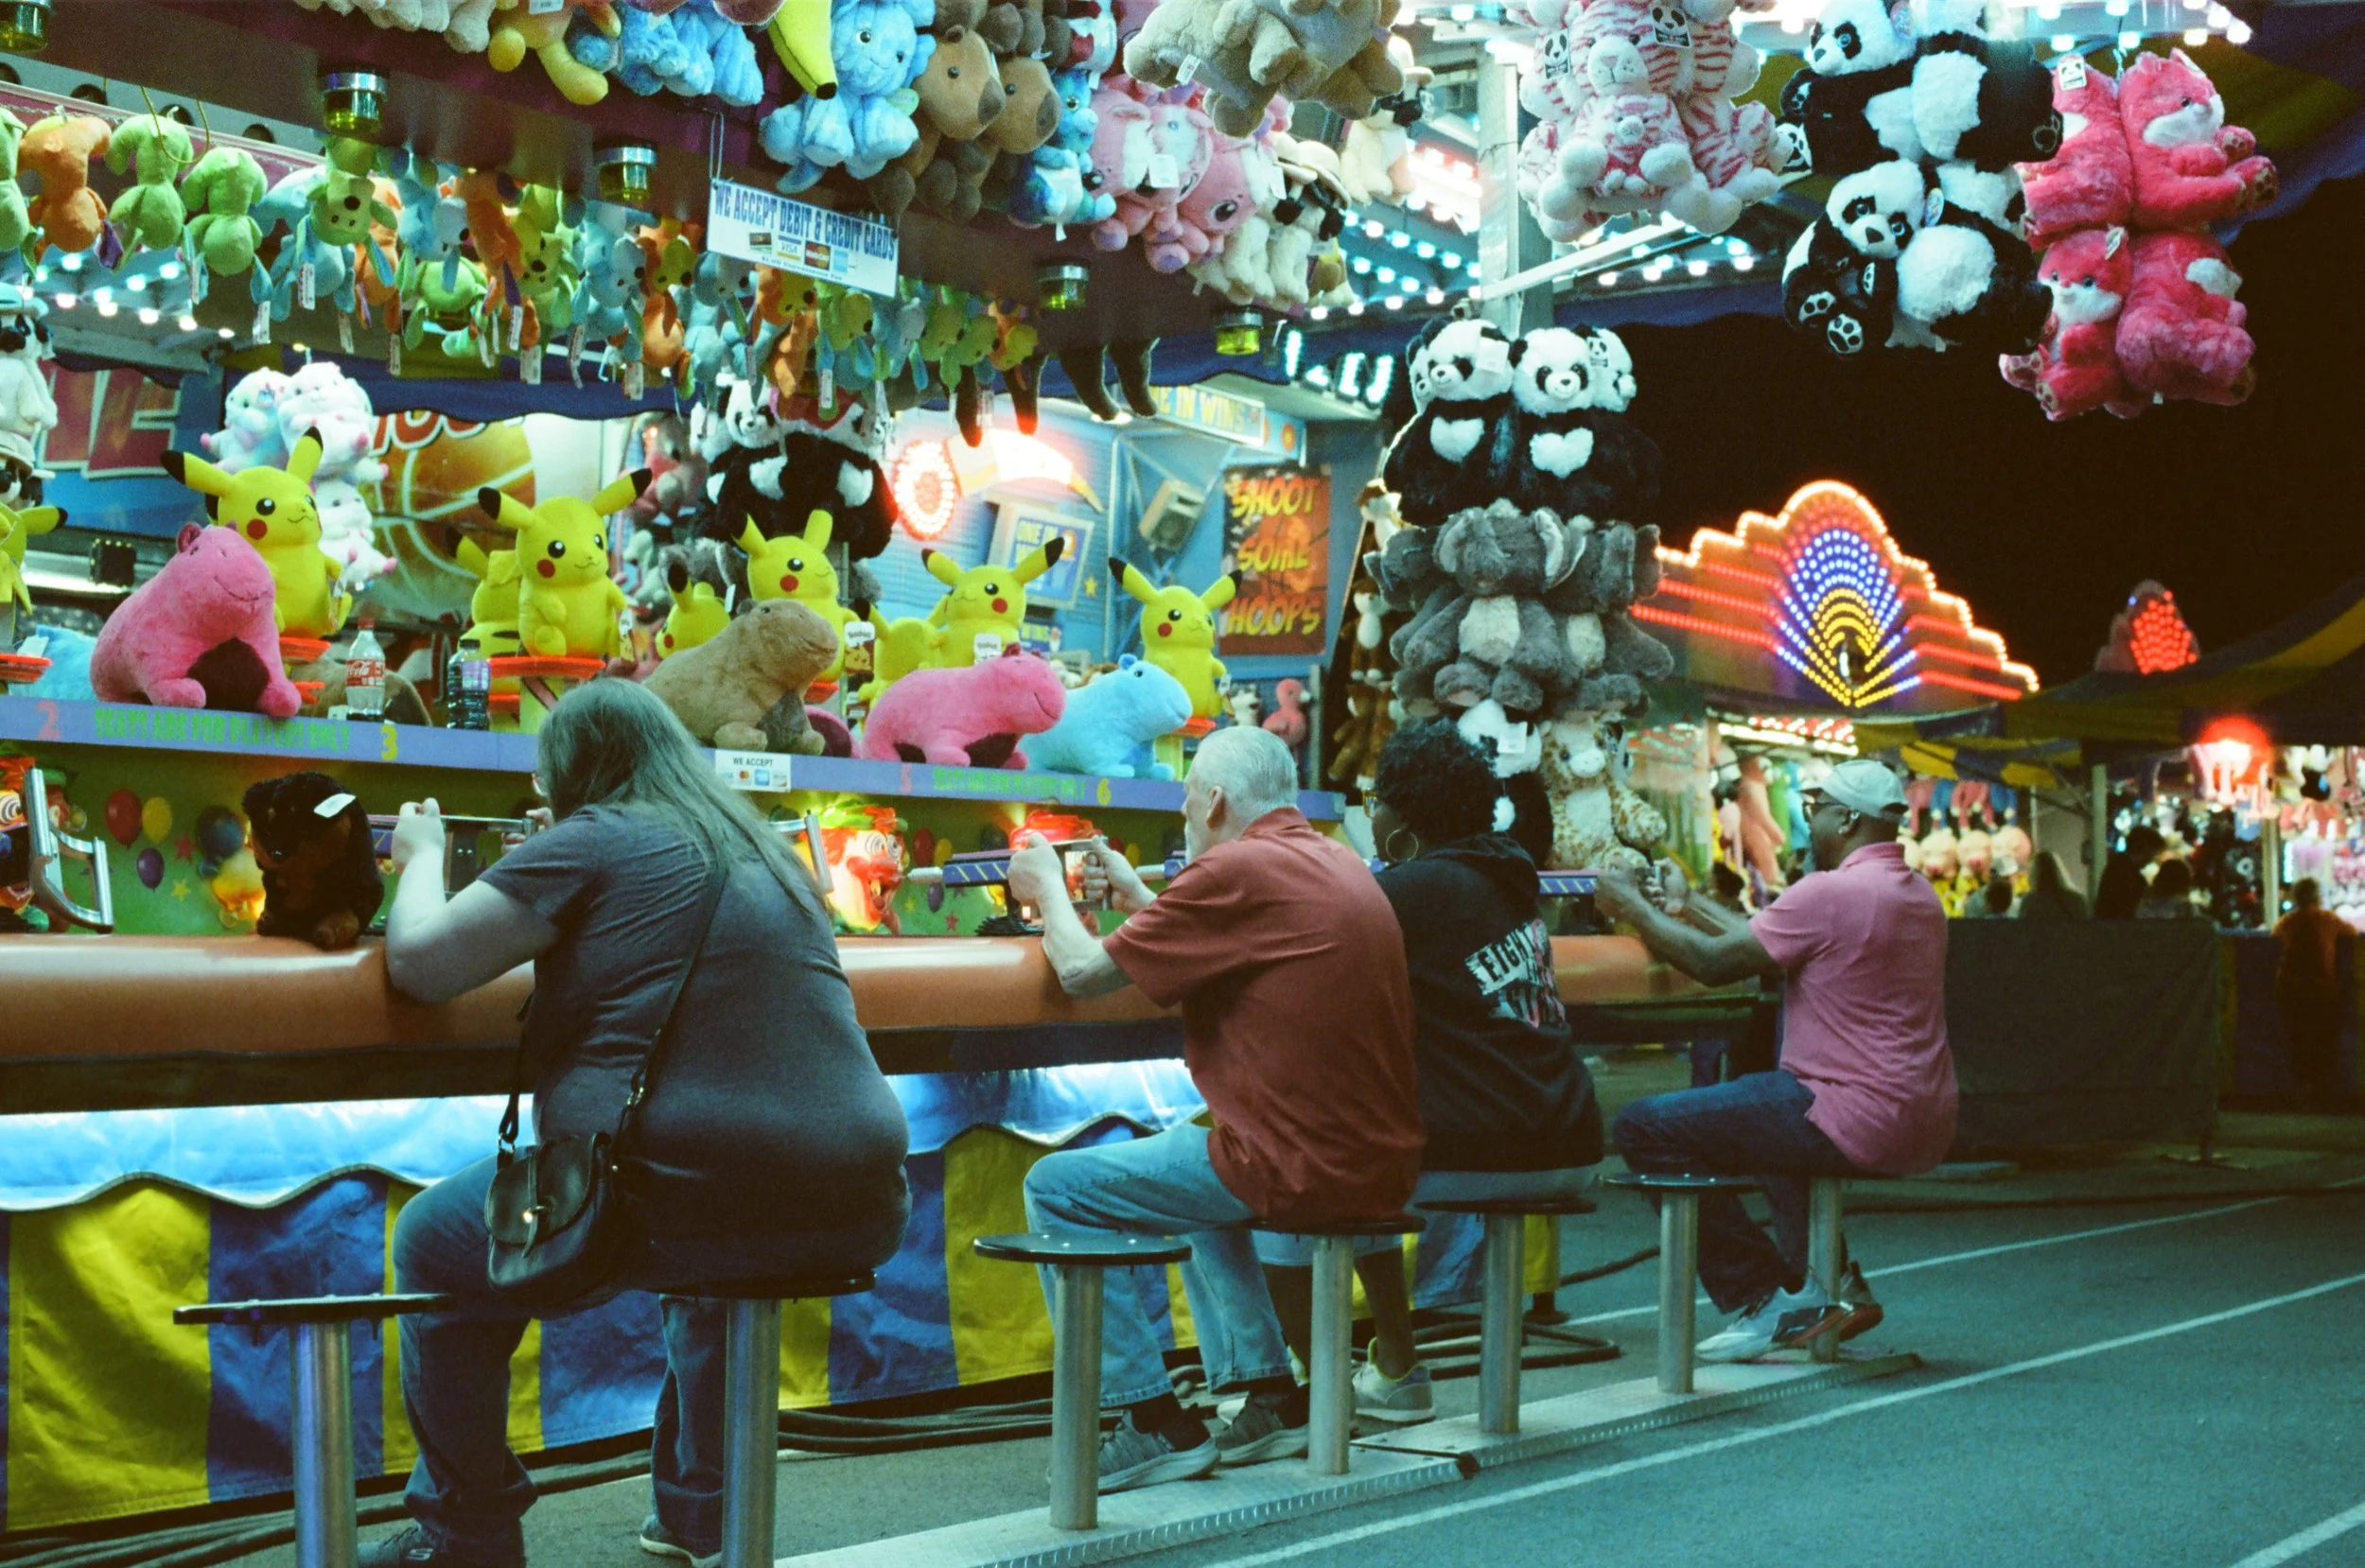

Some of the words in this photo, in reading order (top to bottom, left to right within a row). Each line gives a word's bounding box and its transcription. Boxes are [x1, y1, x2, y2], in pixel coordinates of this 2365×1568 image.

[714, 183, 731, 218] WE
[734, 189, 777, 229] ACCEPT
[780, 200, 812, 237] DEBIT
[814, 210, 822, 241] &
[825, 213, 863, 253] CREDIT
[864, 223, 895, 262] CARDS
[1176, 386, 1197, 420] IN
[1232, 476, 1320, 517] SHOOT
[1225, 594, 1322, 636] HOOPS
[37, 700, 61, 739] 2
[96, 707, 148, 739] SEATS
[151, 709, 186, 742] ARE
[191, 712, 226, 744] FOR
[307, 722, 351, 753] ONLY
[380, 724, 398, 760] 3
[745, 758, 773, 767] ACCEPT
[1096, 777, 1112, 806] 6
